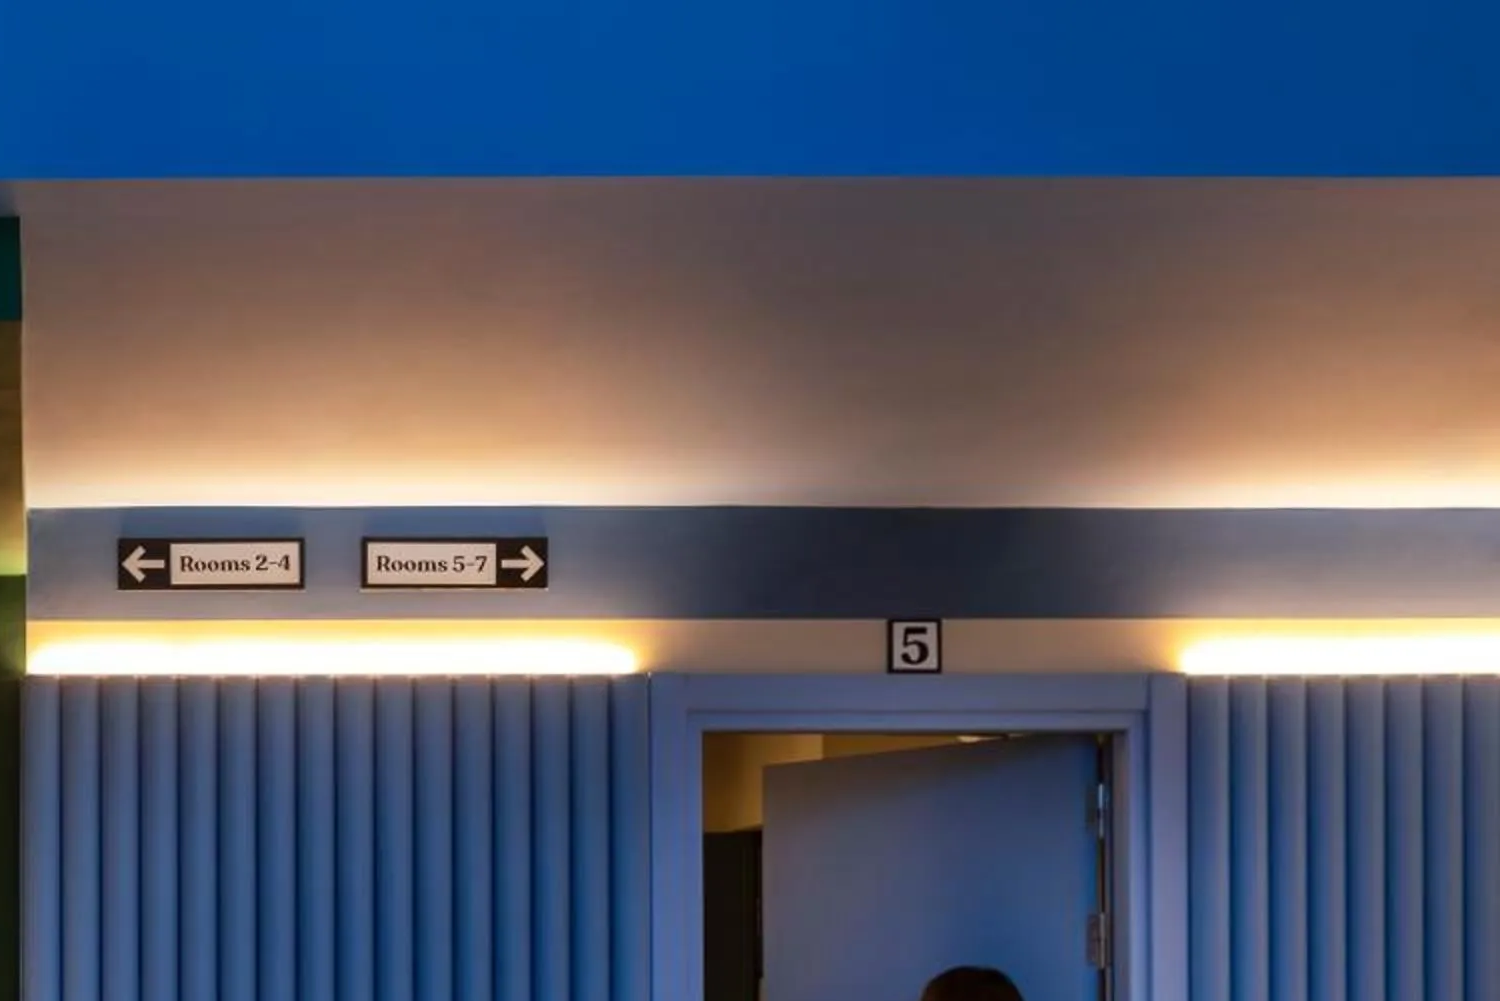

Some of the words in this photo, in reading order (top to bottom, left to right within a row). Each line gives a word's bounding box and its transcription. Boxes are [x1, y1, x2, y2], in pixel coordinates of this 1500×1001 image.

[180, 554, 251, 572] Rooms
[256, 554, 290, 571] 2-4
[377, 555, 448, 572] Rooms
[453, 555, 488, 572] 5-7
[901, 627, 929, 665] 5
